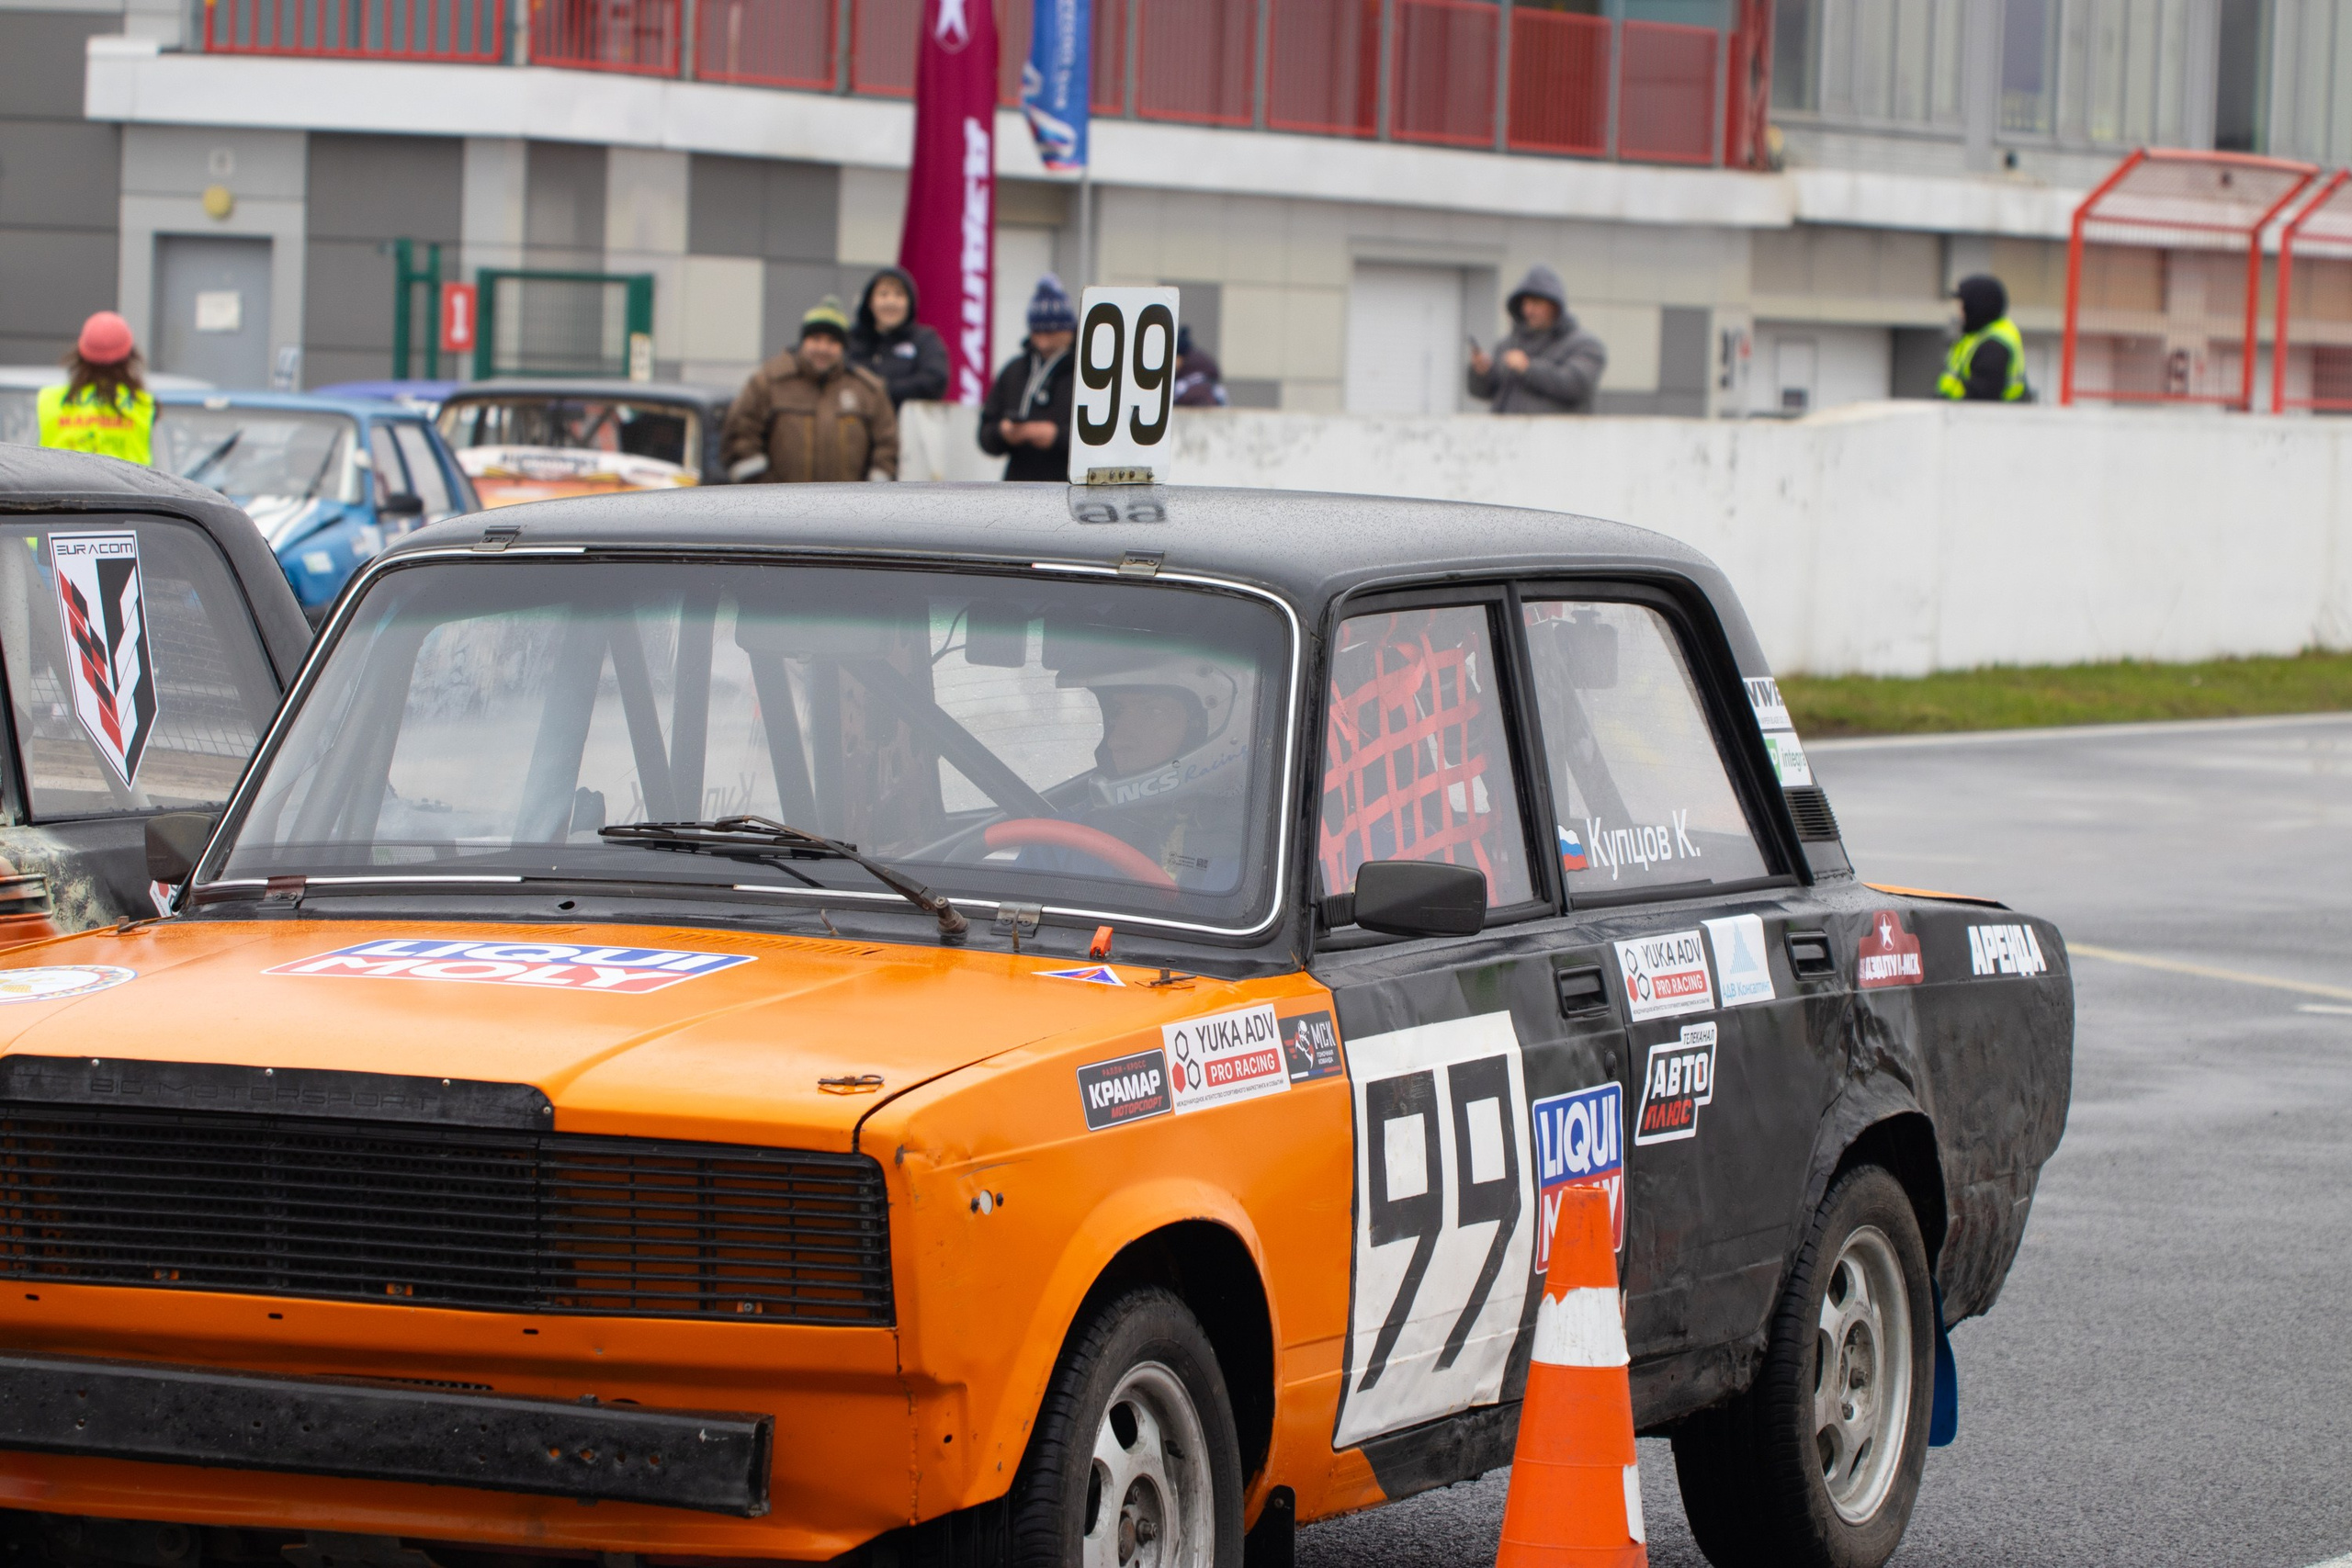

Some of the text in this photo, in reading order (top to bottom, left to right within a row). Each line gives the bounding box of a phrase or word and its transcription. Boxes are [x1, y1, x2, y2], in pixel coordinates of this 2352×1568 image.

[1078, 302, 1175, 446] 99
[56, 543, 133, 556] EURACOM
[1116, 771, 1181, 805] NCS
[1586, 808, 1702, 881] Купцов К.
[352, 941, 729, 972] LIQUI
[1641, 938, 1702, 969] YUKA ADV
[1968, 924, 2047, 976] АРЕНДА
[293, 956, 687, 989] MOLY
[1655, 975, 1704, 996] PRO RACING
[1195, 1011, 1274, 1054] YUKA ADV
[1310, 1021, 1337, 1050] МСК
[1683, 1029, 1714, 1045] ТЕЛЕКАНАЛ
[1210, 1053, 1276, 1083] PRO RACING
[1651, 1052, 1709, 1100] АВТО
[91, 1077, 144, 1095] BIG
[1089, 1069, 1160, 1110] КРАМАР
[1111, 1095, 1162, 1119] МОТОРСПОРТ
[1644, 1099, 1692, 1131] ПЛЮС
[1540, 1094, 1618, 1179] LIQUI
[1357, 1054, 1521, 1394] 99
[1542, 1175, 1621, 1263] MY
